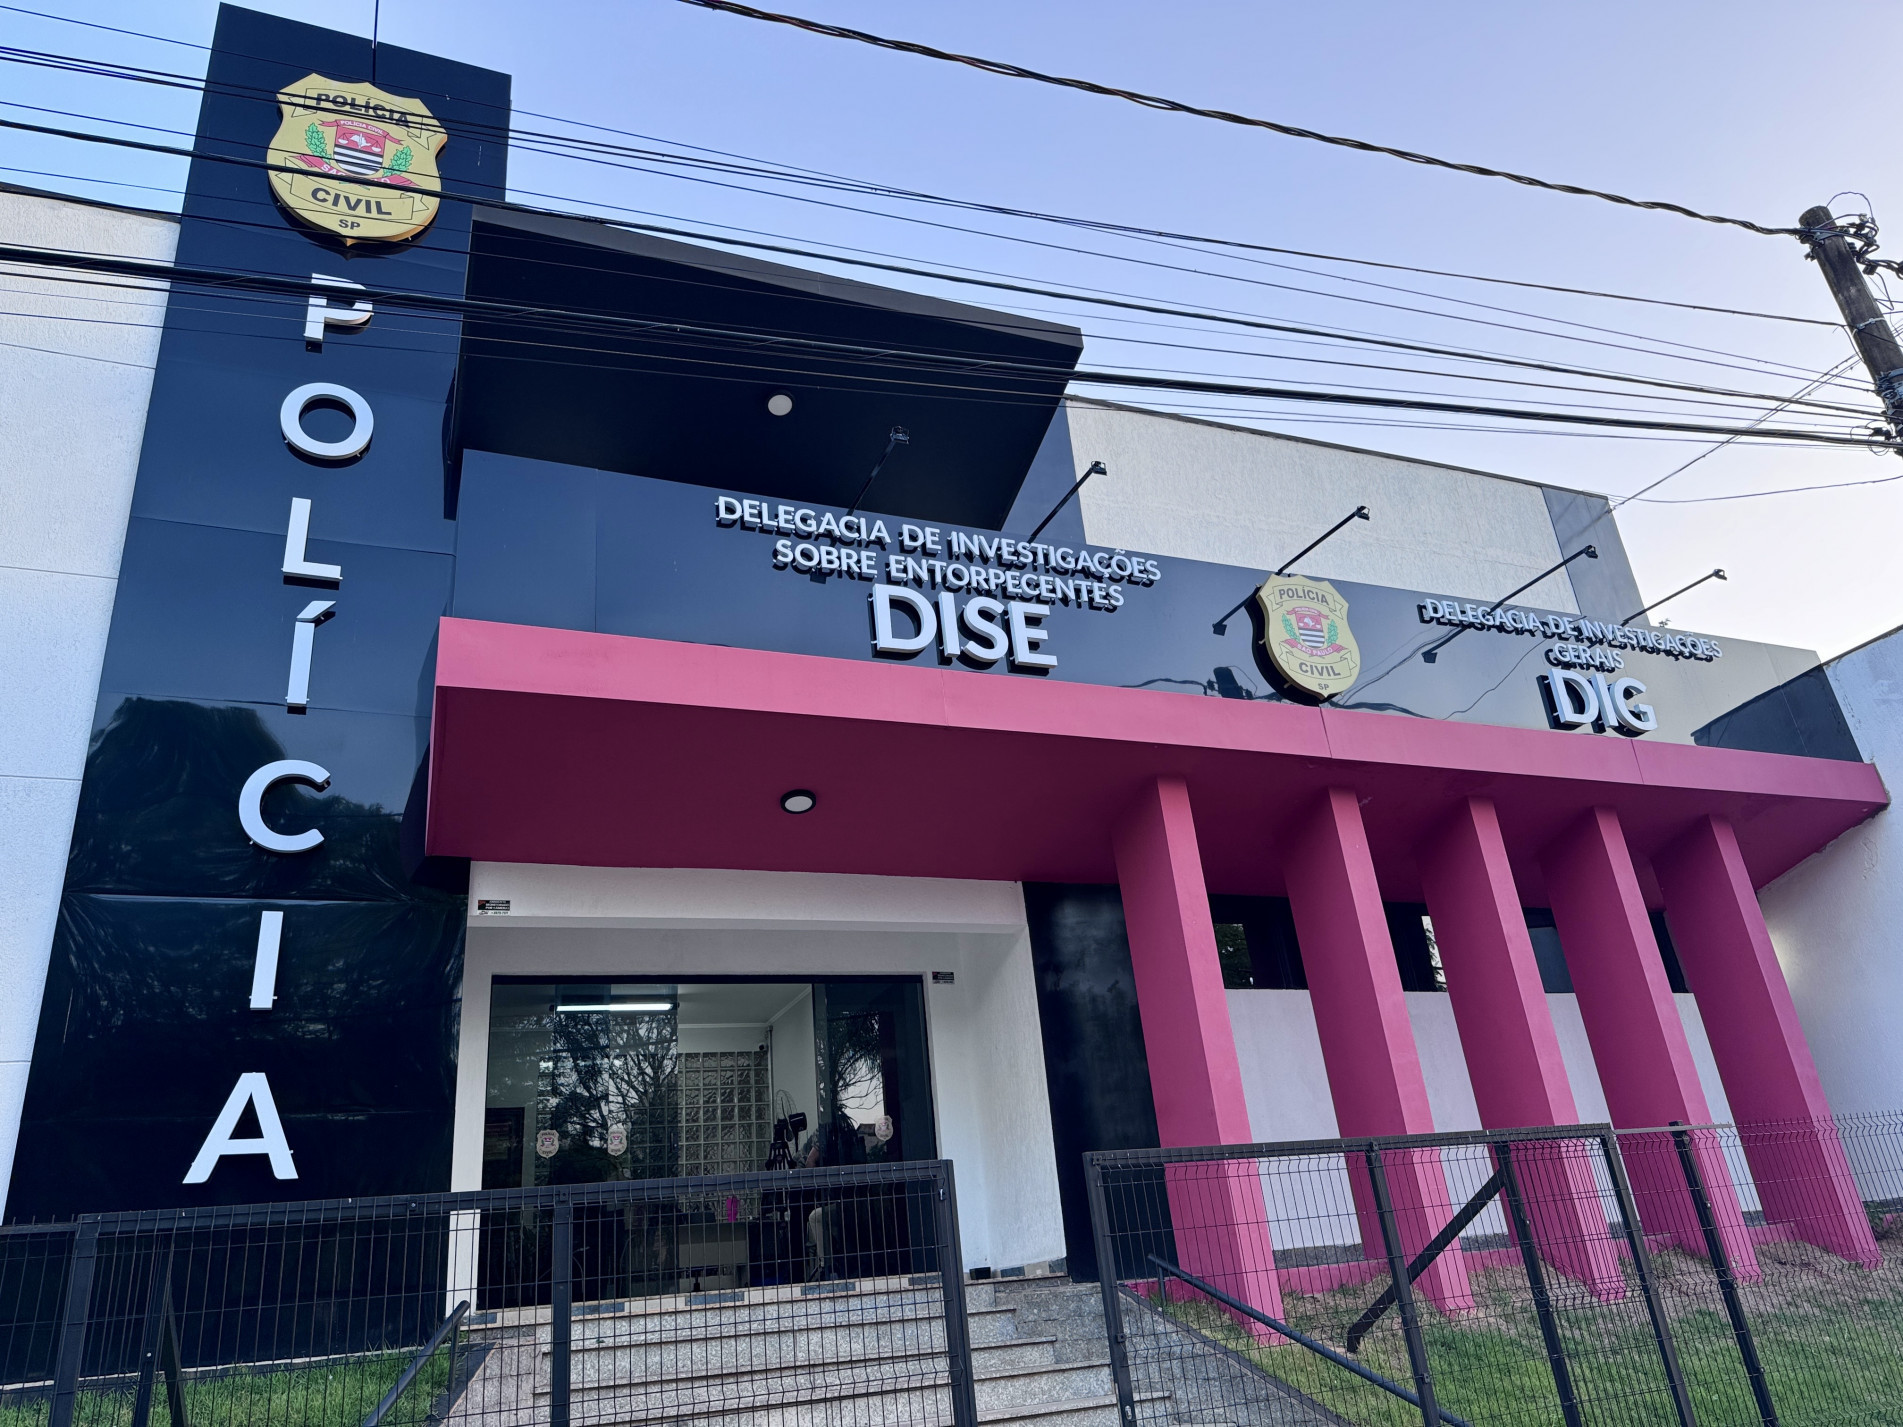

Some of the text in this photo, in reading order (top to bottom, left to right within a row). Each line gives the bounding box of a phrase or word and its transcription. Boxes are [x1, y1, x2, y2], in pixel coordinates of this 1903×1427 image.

[316, 93, 411, 129] POLÍCIA
[368, 125, 384, 135] CIVIL
[311, 187, 392, 216] CIVIL
[338, 219, 361, 231] SP
[717, 495, 1162, 582] DELEGACIA DE INVESTIGAÇÕES
[776, 539, 1124, 608] SOBRE ENTORPECENTES
[1279, 586, 1330, 606] POLÍCIA
[871, 583, 1058, 670] DISE
[1424, 598, 1723, 659] DELEGACIA DE INVESTIGAÇÕES
[1312, 647, 1333, 656] PAULO
[1553, 643, 1625, 670] GERAIS
[1299, 662, 1341, 677] CIVIL
[1318, 683, 1329, 691] SP
[1549, 667, 1659, 733] DIG
